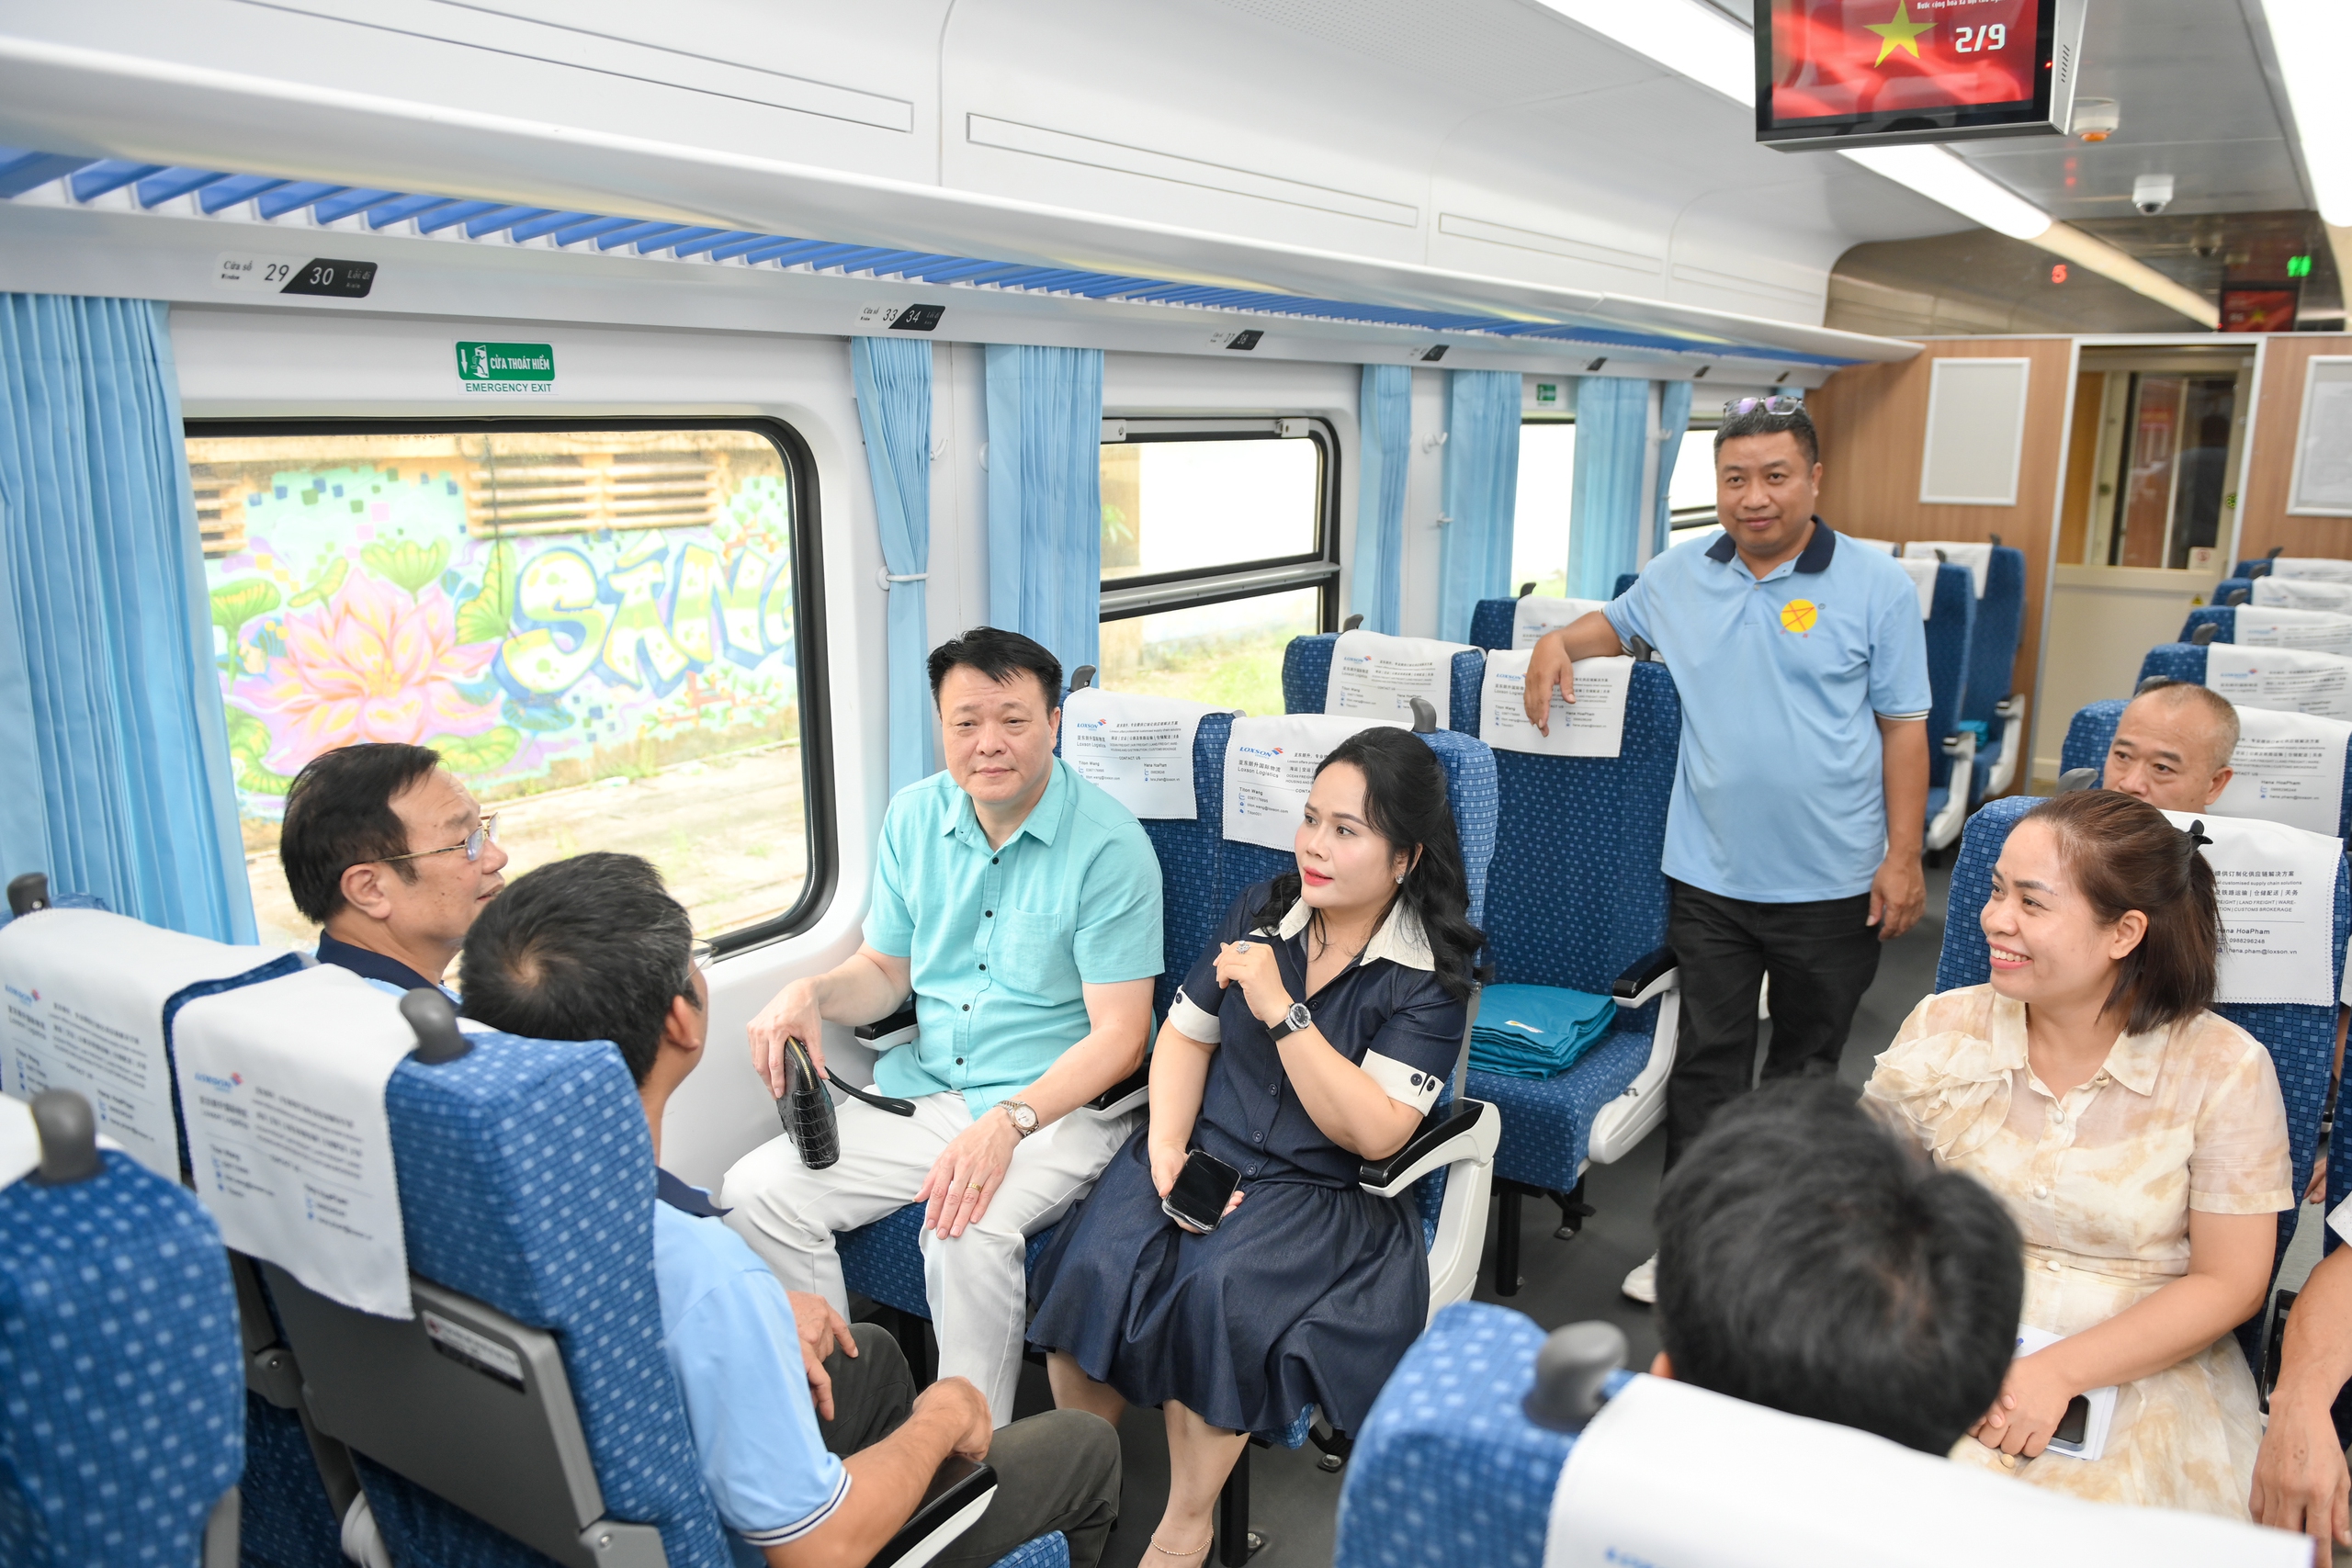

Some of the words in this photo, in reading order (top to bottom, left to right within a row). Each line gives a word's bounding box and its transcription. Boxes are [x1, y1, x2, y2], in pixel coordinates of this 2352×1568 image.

[1955, 23, 2006, 53] 2/9
[265, 264, 289, 282] 29
[310, 266, 334, 285] 30
[883, 309, 898, 321] 33
[906, 310, 921, 323] 34
[490, 354, 507, 369] CỬA
[507, 355, 530, 369] THOÁT
[532, 355, 550, 370] HIỂM
[466, 383, 528, 391] EMERGENCY
[531, 383, 551, 392] EXIT
[1239, 746, 1272, 758] LOXSON
[1256, 770, 1279, 778] Logistics
